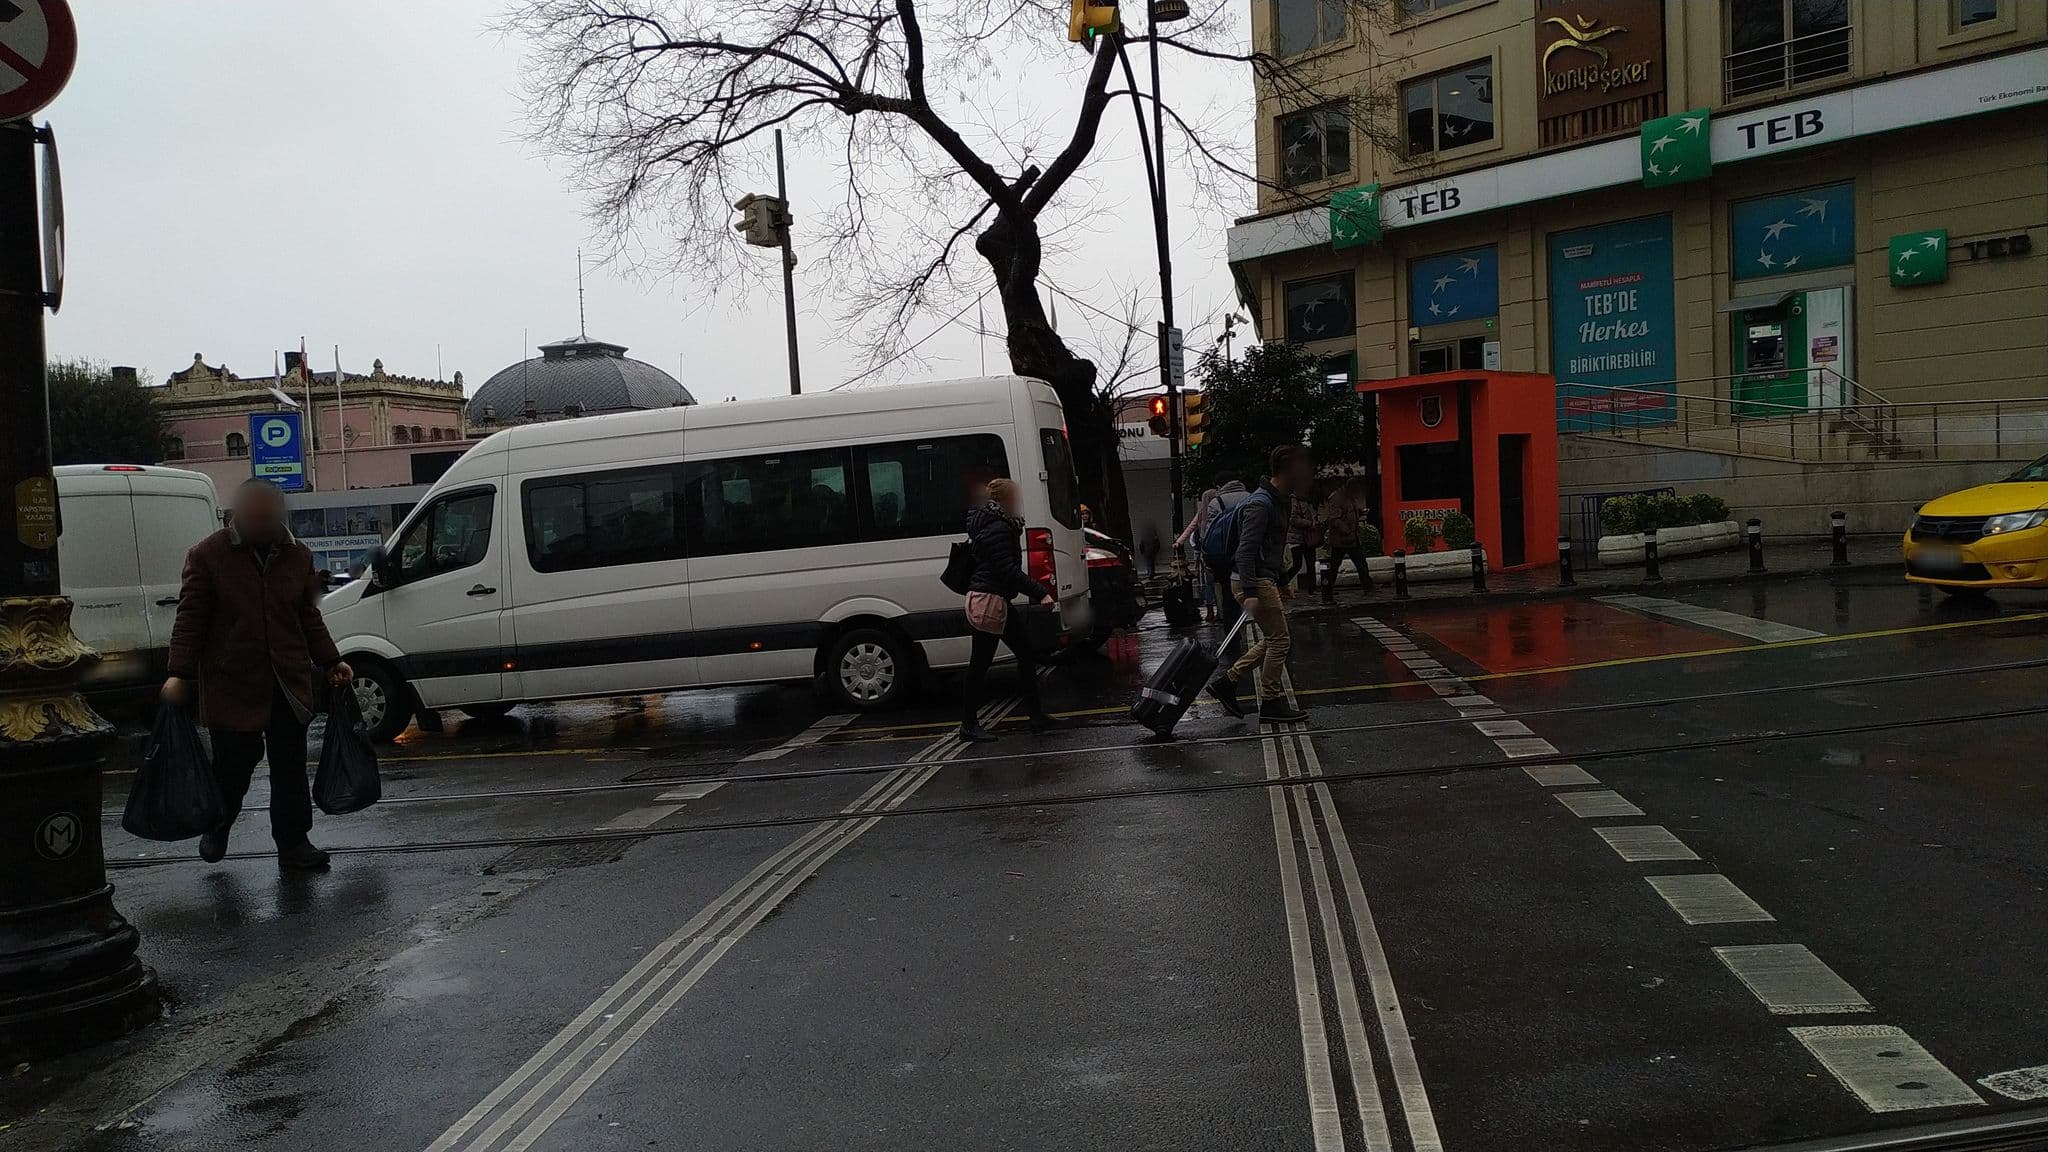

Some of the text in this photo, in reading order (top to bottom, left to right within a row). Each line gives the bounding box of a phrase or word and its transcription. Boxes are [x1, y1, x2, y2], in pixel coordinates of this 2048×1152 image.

[1978, 94, 1997, 103] Türk
[1998, 86, 2034, 100] Ekonomi
[1737, 109, 1824, 149] TEB
[1399, 187, 1461, 218] TEB
[1578, 319, 1650, 344] Herkes
[1570, 349, 1656, 374] BİRİKTİREBİLİR!
[305, 537, 380, 548] TOURIST INFORMATION
